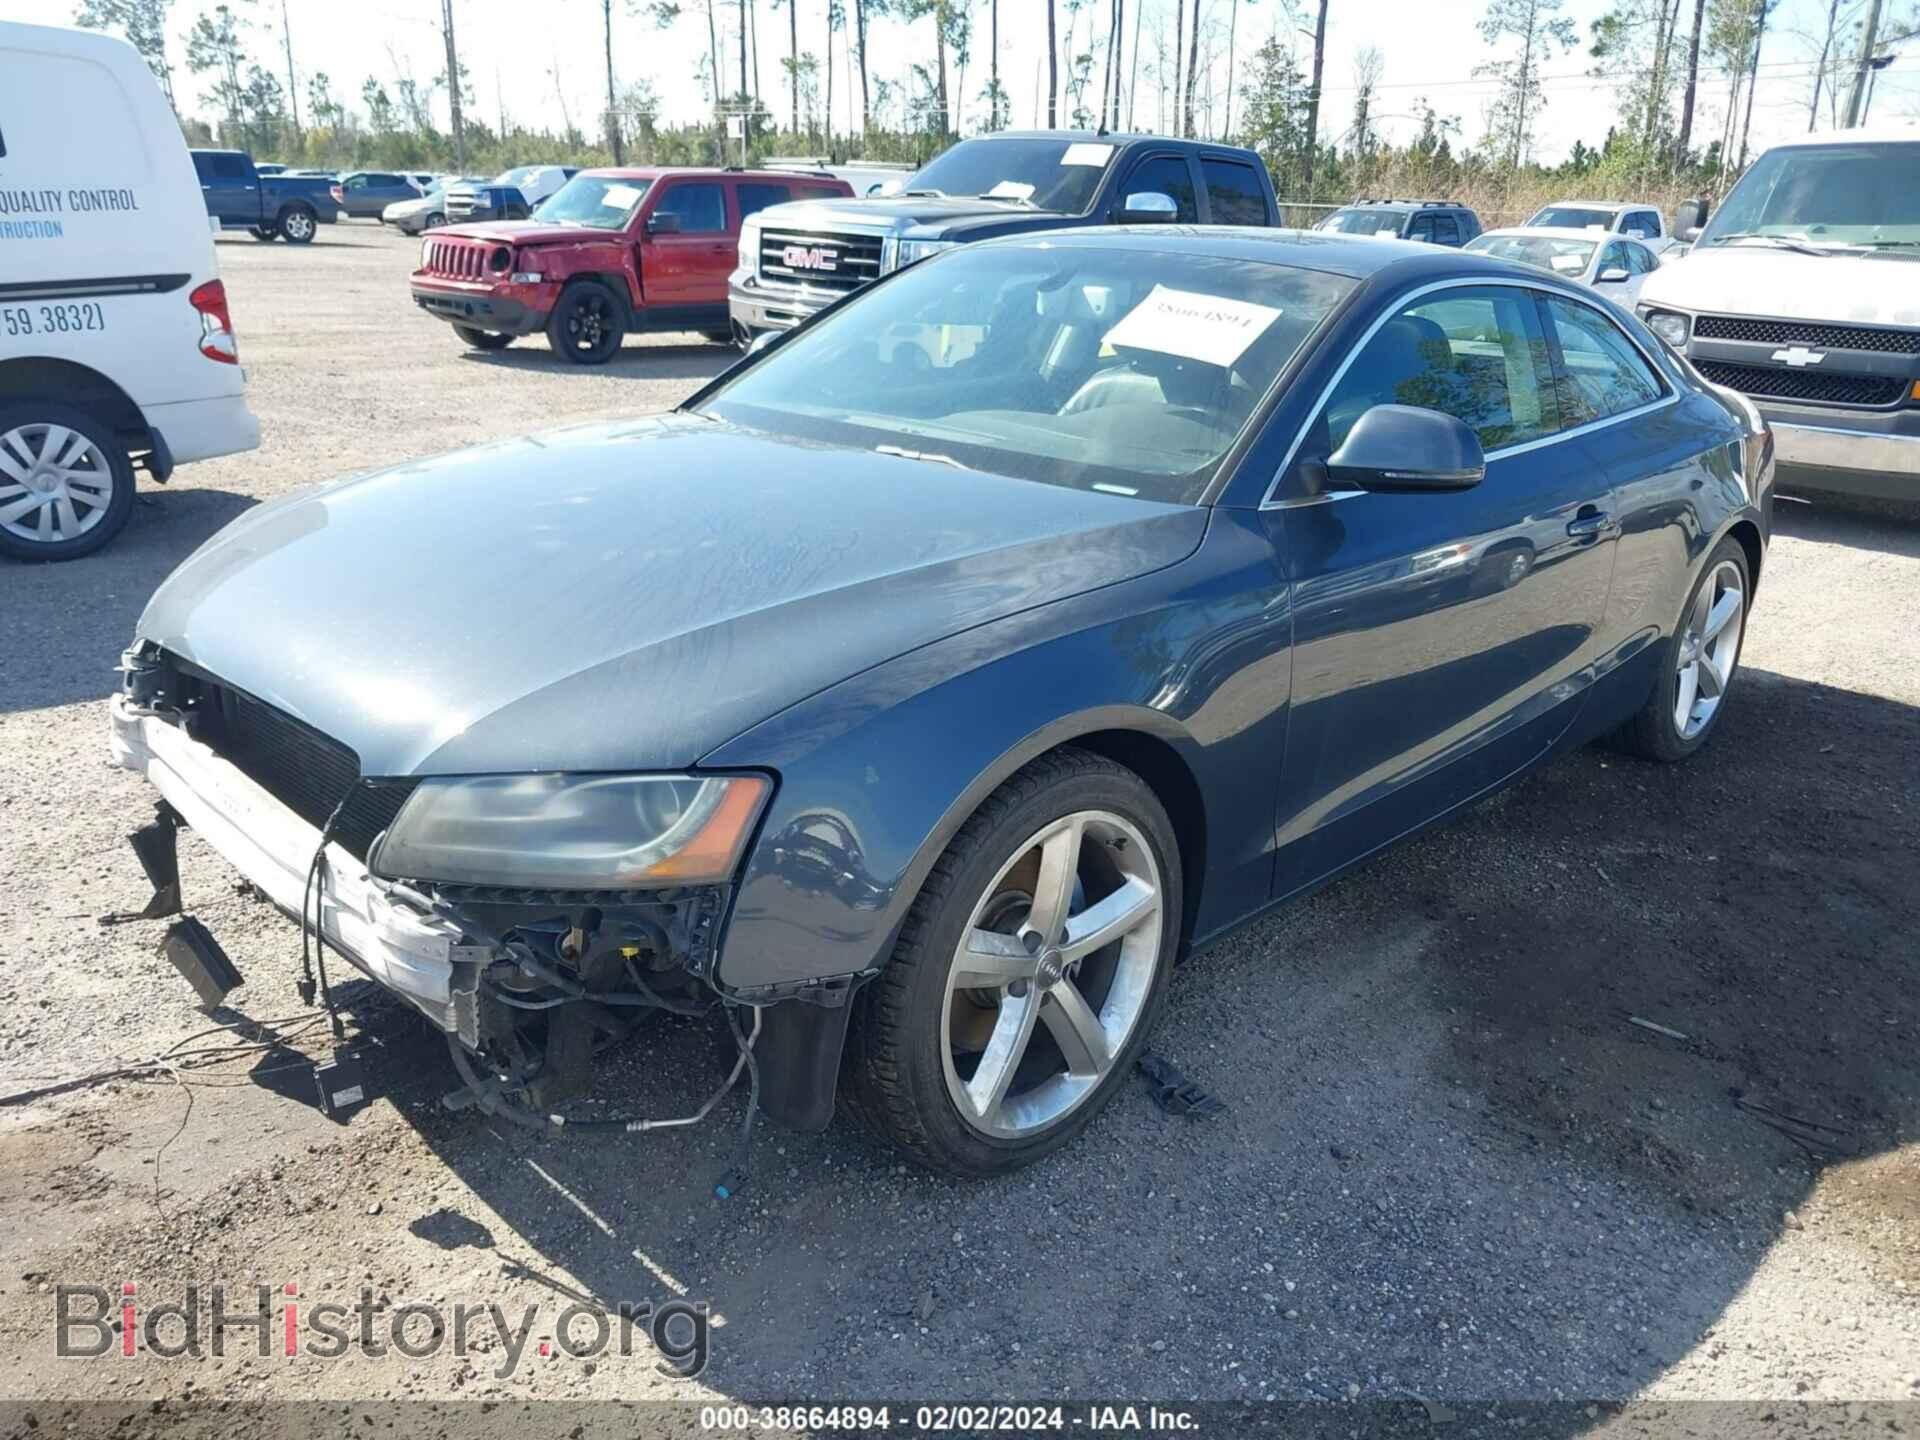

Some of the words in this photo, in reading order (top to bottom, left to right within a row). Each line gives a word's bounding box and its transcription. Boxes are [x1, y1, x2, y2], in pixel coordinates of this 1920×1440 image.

[0, 190, 63, 214] QUALITY
[69, 189, 140, 212] CONTROL
[783, 246, 838, 271] GMC
